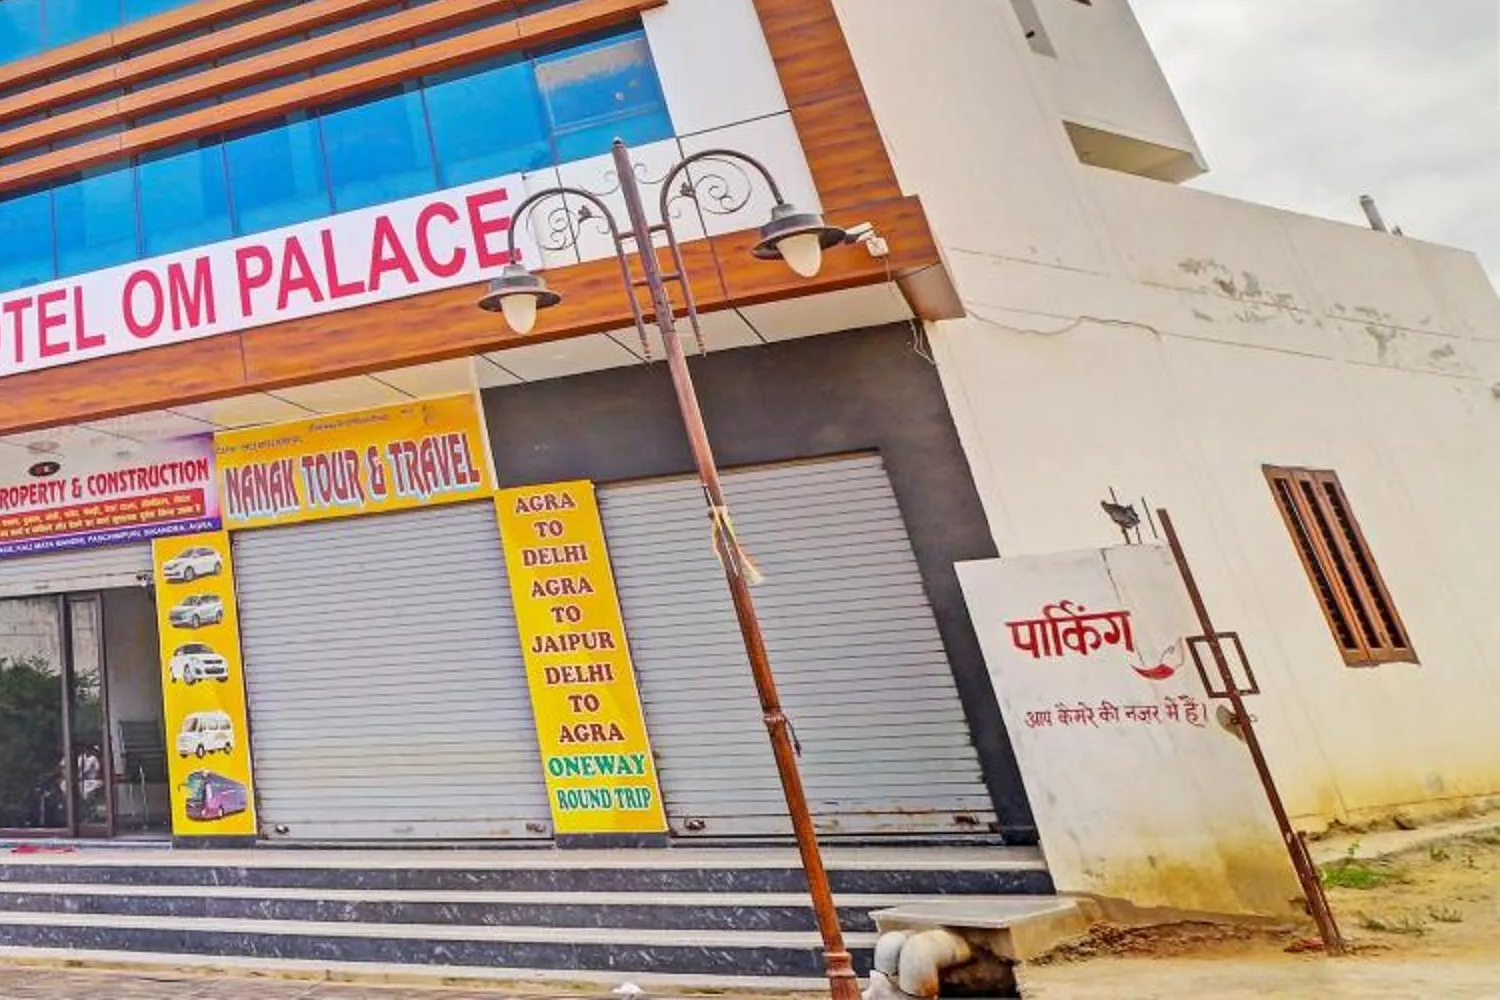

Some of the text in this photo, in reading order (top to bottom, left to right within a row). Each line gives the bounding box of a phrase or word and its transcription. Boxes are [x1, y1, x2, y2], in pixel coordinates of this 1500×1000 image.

[122, 256, 216, 339] OM
[235, 188, 522, 317] PALACE
[71, 477, 81, 497] &
[87, 458, 210, 495] CONSTRUCTION
[224, 432, 481, 518] NANAK TOUR & TRAVEL
[515, 492, 576, 513] AGRA
[534, 520, 563, 537] TO
[522, 544, 588, 566] DELHI
[531, 576, 595, 597] AGRA
[551, 605, 581, 623] TO
[1005, 600, 1135, 659] पार्किंग
[531, 631, 615, 653] JAIPUR
[544, 663, 614, 685] DELHI
[568, 694, 600, 712] TO
[1026, 710, 1052, 728] आप
[1100, 700, 1119, 723] की
[559, 724, 625, 743] AGRA
[547, 754, 645, 777] ONEWAY
[556, 787, 652, 811] ROUND TRIP
